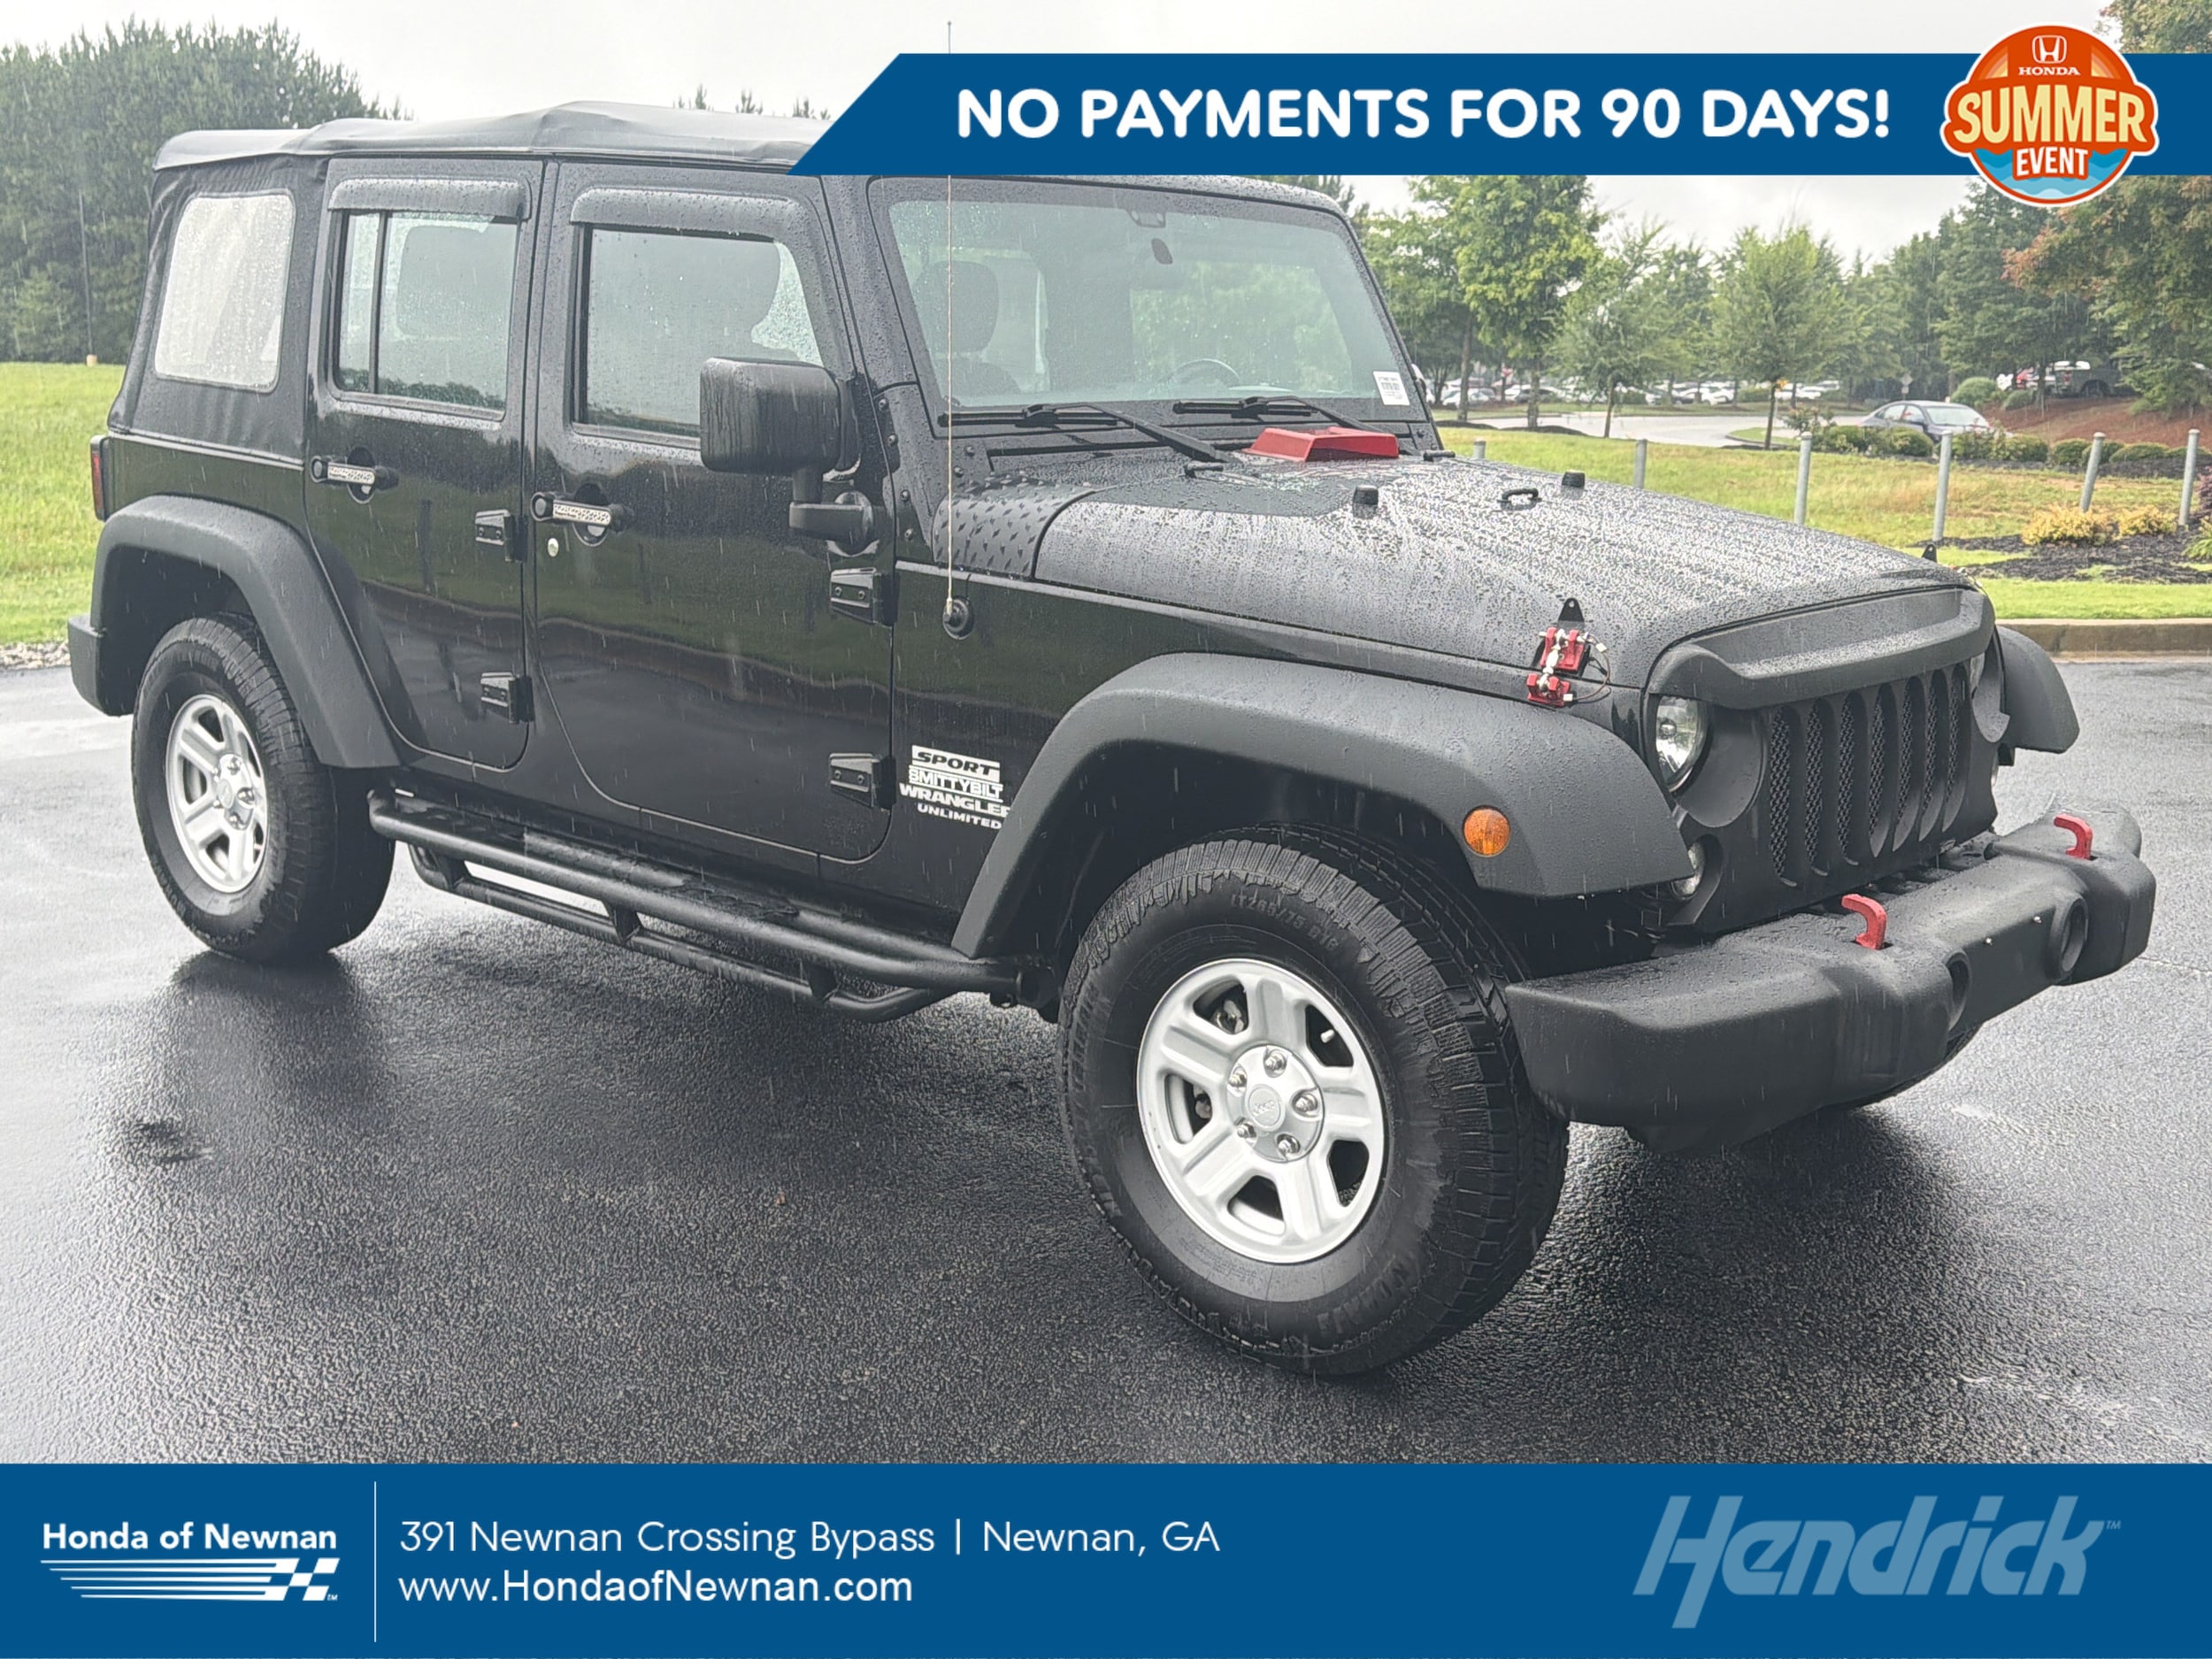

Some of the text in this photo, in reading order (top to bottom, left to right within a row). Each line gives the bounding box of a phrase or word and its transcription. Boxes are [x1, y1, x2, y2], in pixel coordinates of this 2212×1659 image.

[917, 750, 999, 776] SPORT
[908, 764, 1003, 803] SMITTYBILT
[917, 803, 1002, 829] UNLIMITED
